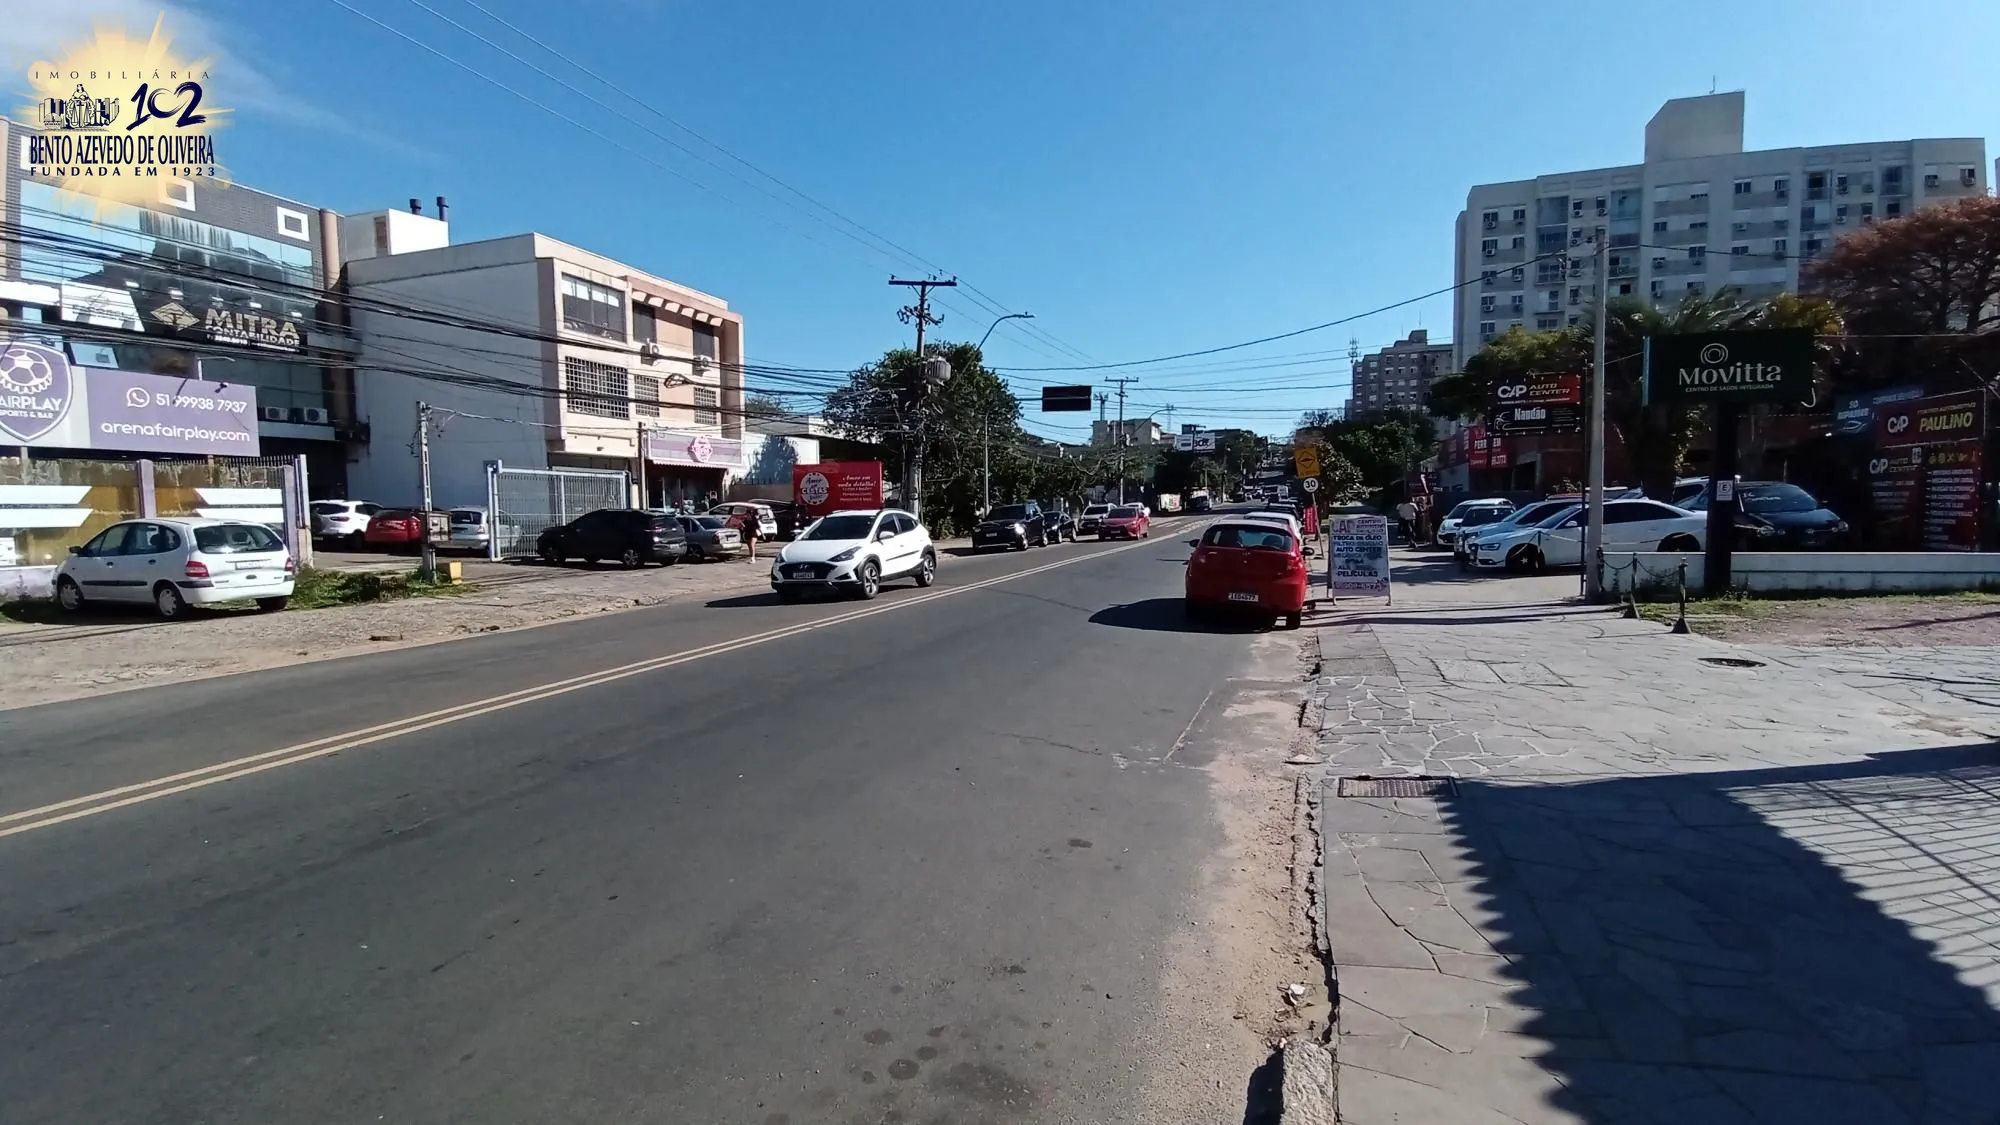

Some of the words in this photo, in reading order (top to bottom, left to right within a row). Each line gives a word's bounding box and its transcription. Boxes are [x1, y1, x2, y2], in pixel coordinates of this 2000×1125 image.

[205, 308, 300, 340] MITRA
[204, 325, 300, 347] CONTABILIDADE
[1678, 361, 1782, 385] Movitta
[0, 395, 63, 411] AIRPLAY
[1529, 388, 1570, 397] CENTER
[155, 394, 171, 408] 51
[173, 395, 214, 411] 99938
[217, 399, 248, 414] 7937
[100, 421, 250, 443] arenafairplay.com
[1919, 412, 1974, 433] PAULINO
[1305, 479, 1316, 488] 30
